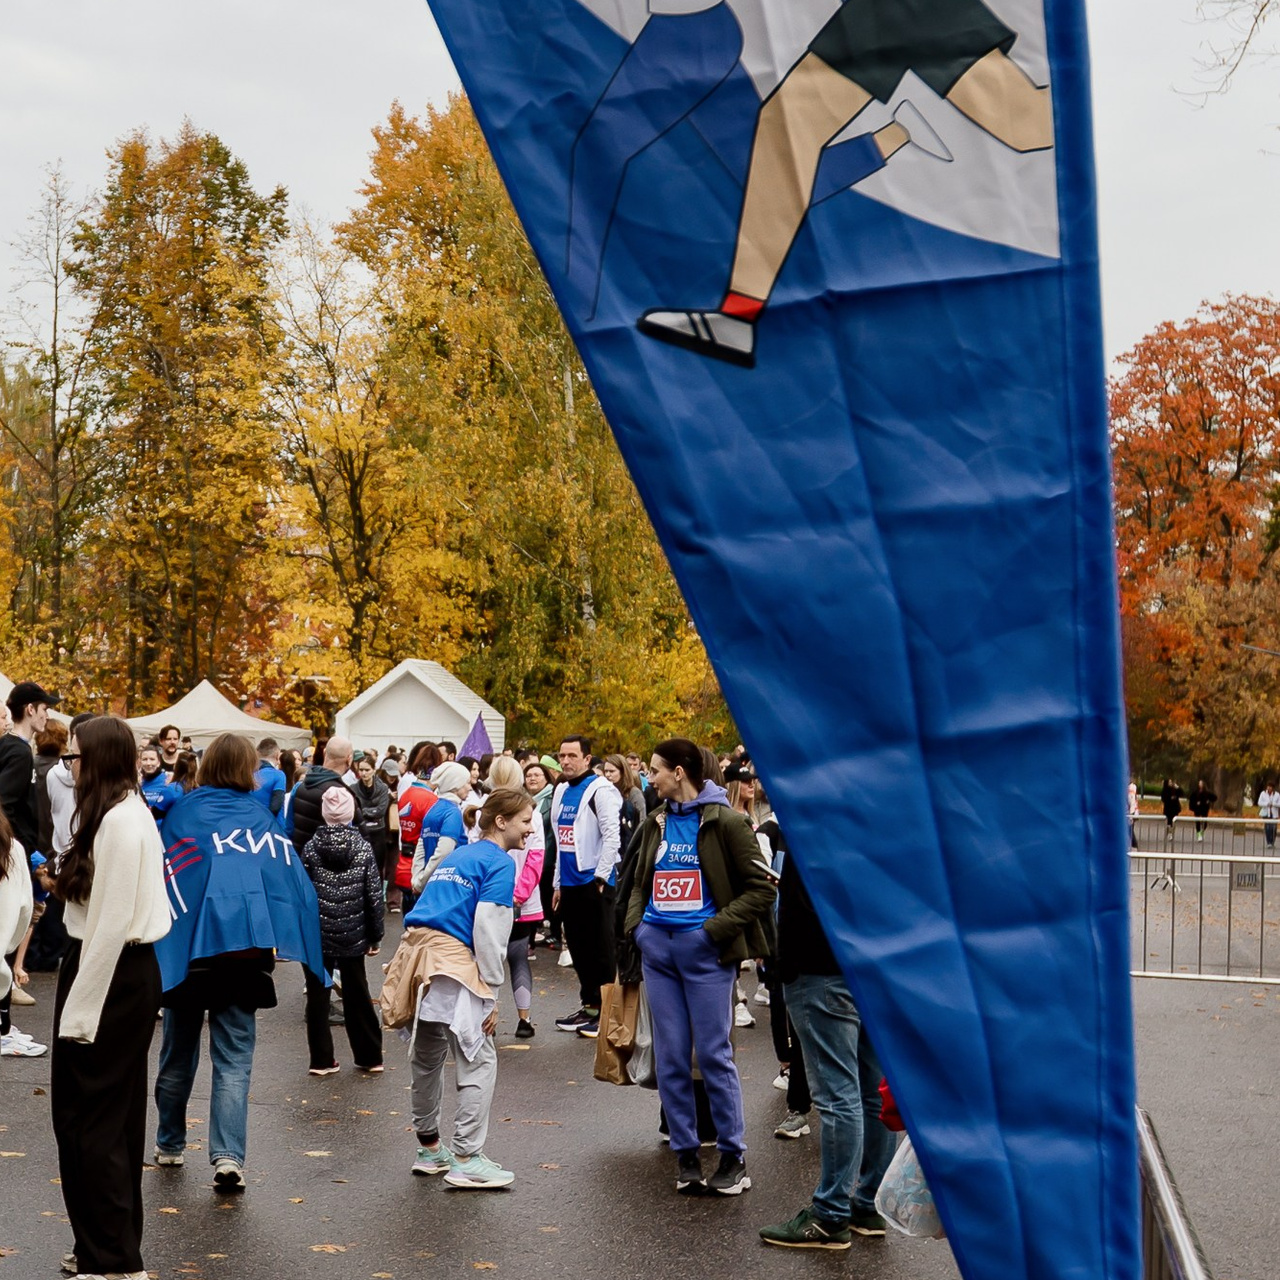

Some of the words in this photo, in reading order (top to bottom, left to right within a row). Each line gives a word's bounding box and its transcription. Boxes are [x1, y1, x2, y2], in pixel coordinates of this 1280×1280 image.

[212, 828, 293, 866] КИТ
[670, 843, 694, 853] БЕГУ
[668, 853, 680, 863] ЗА
[656, 877, 695, 899] 367
